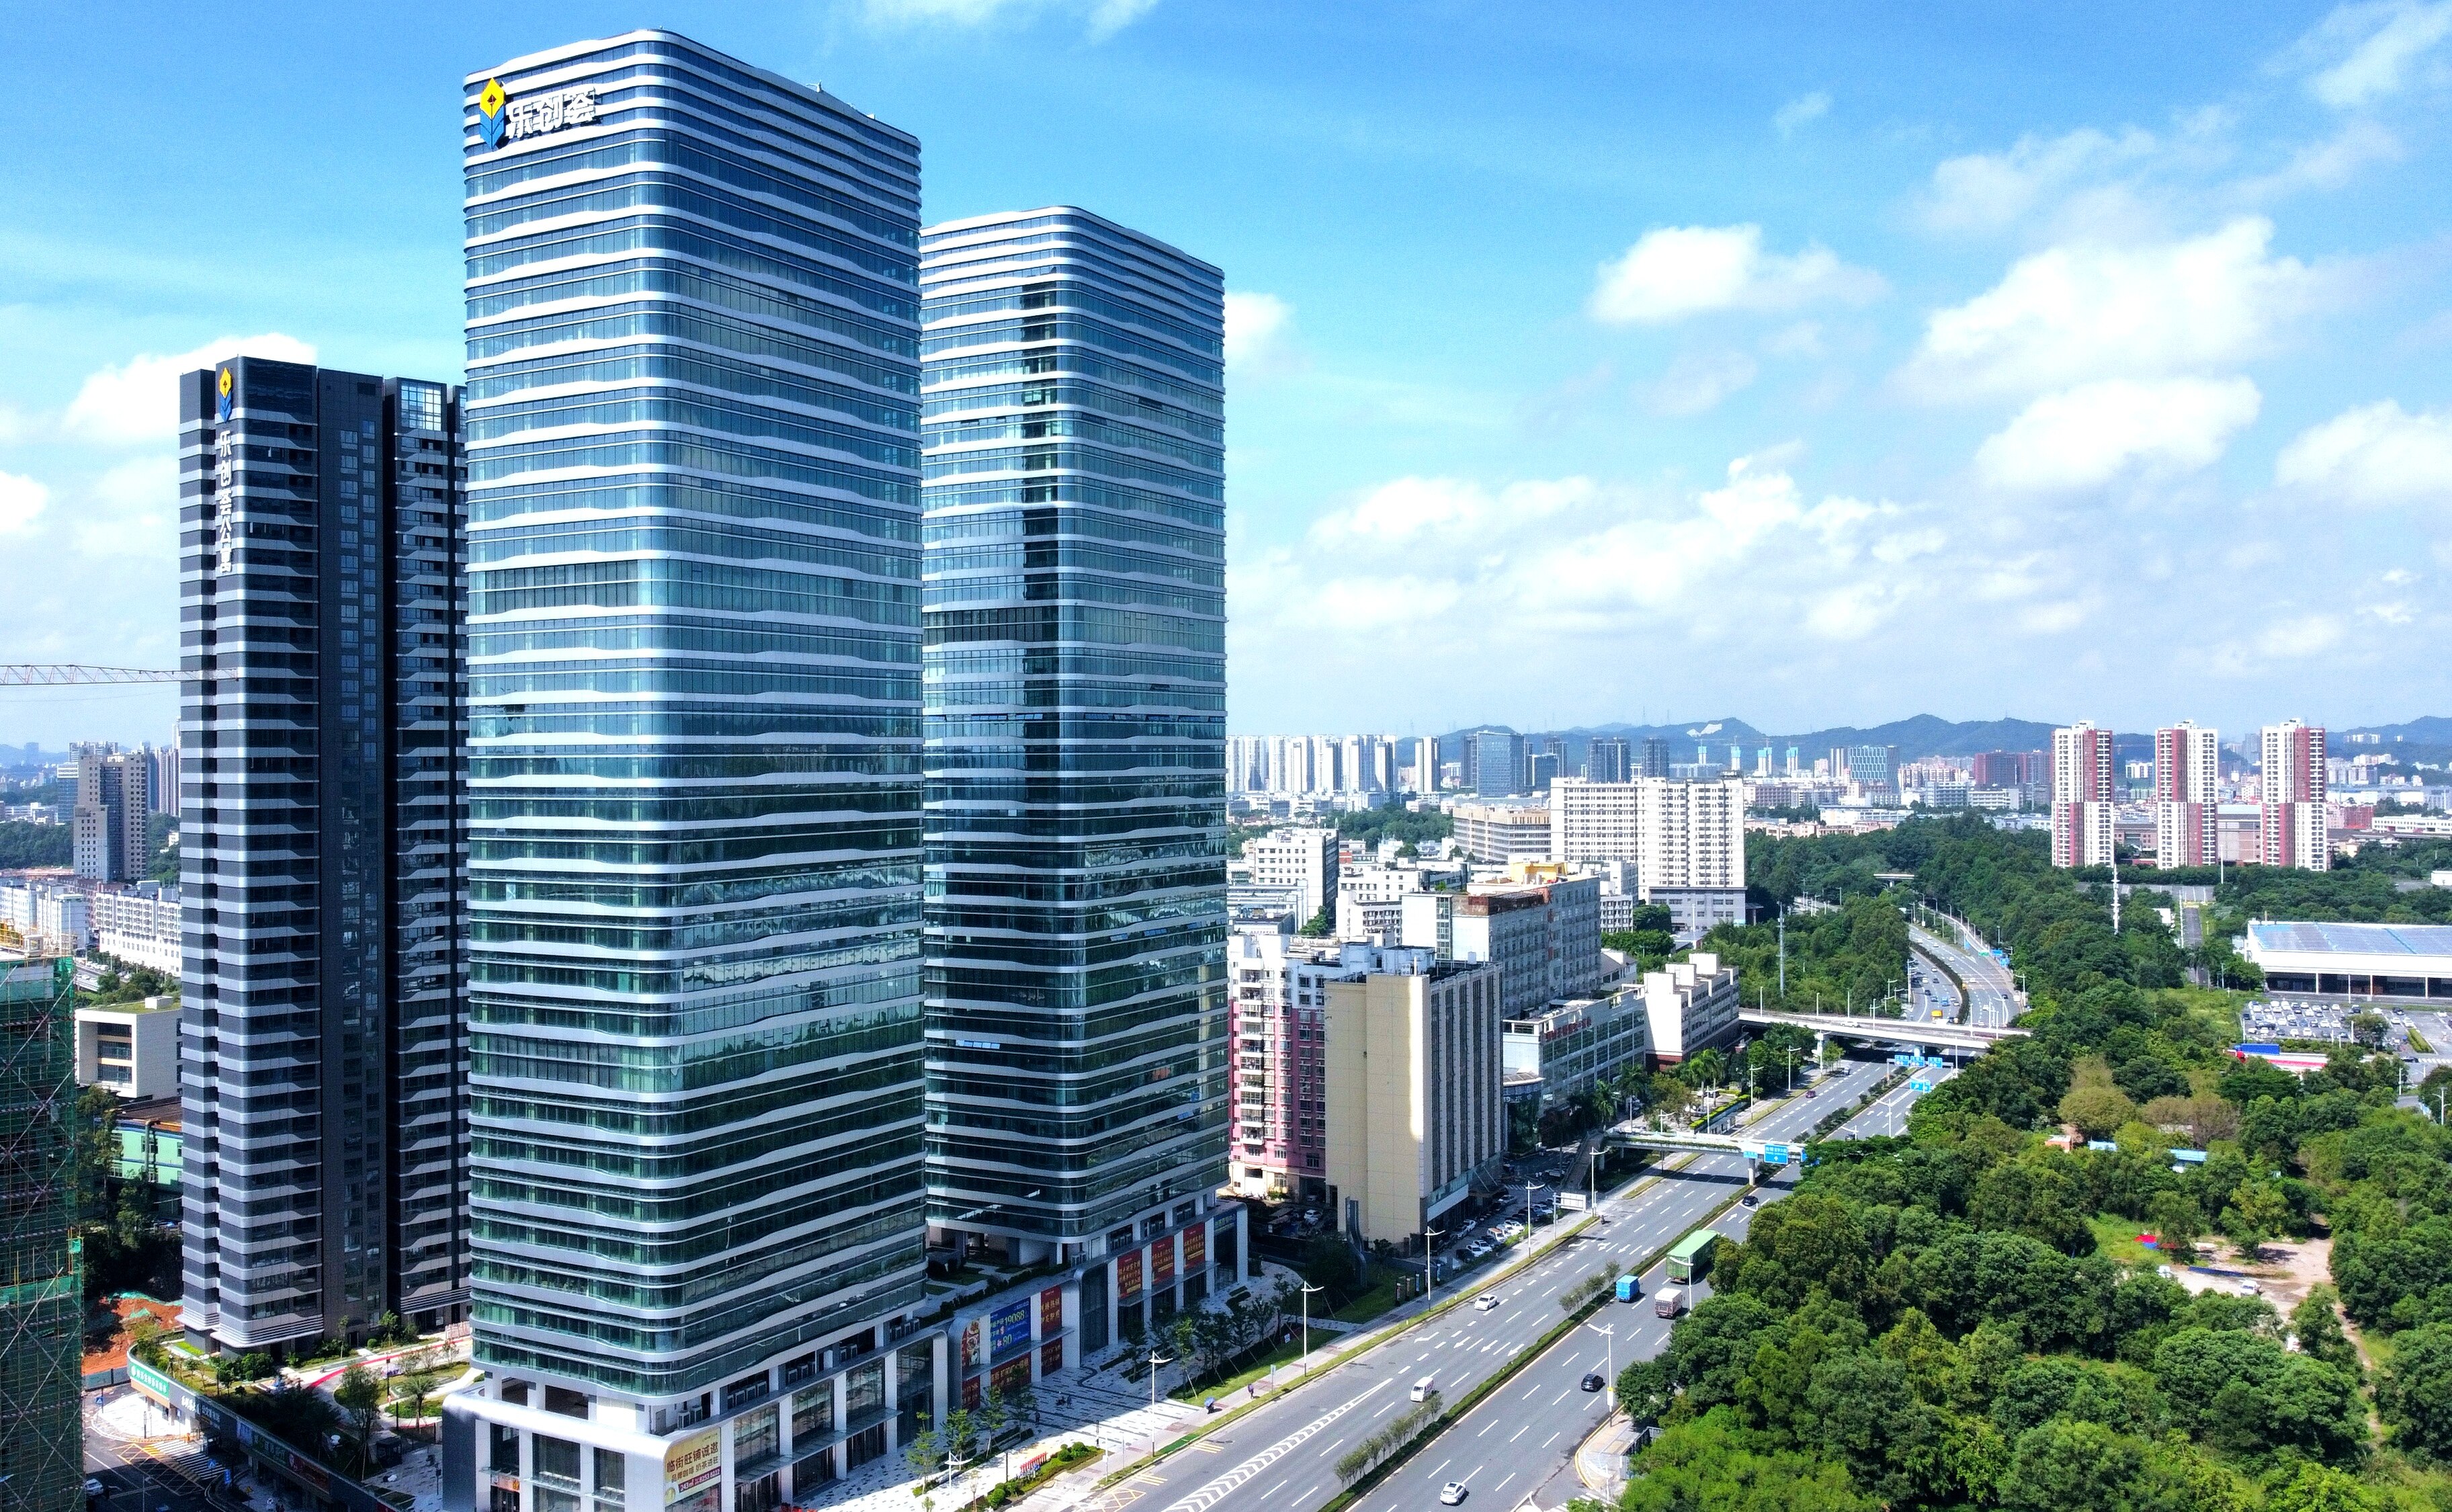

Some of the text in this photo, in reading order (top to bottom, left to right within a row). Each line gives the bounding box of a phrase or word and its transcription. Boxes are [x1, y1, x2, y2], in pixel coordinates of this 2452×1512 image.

[505, 87, 596, 139] 乐创荟
[219, 431, 232, 573] 乐创荟公寓
[667, 1441, 718, 1473] 临街旺铺诚邀
